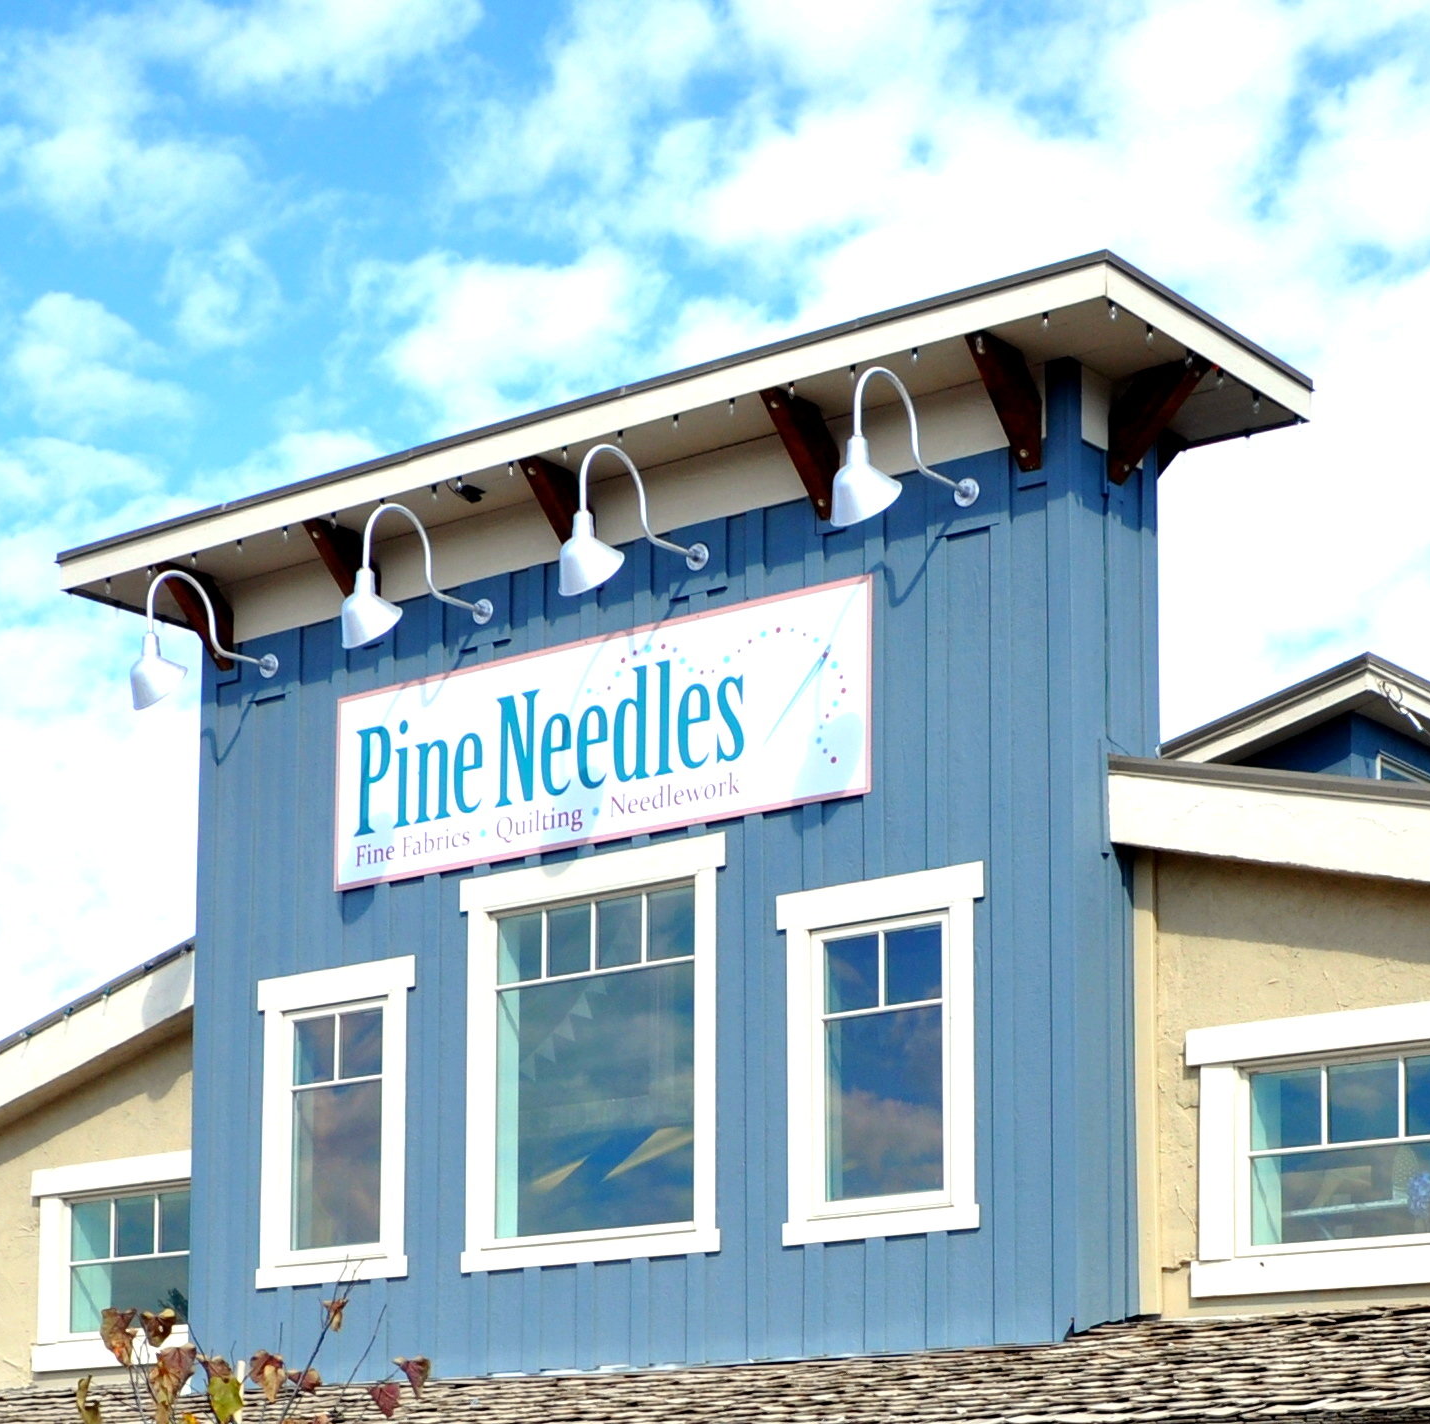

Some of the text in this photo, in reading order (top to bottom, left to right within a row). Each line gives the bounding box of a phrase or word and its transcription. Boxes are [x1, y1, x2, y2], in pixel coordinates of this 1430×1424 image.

[354, 660, 745, 838] Pine Needles
[355, 771, 740, 868] Fine Fabrics Quilting Needlework
